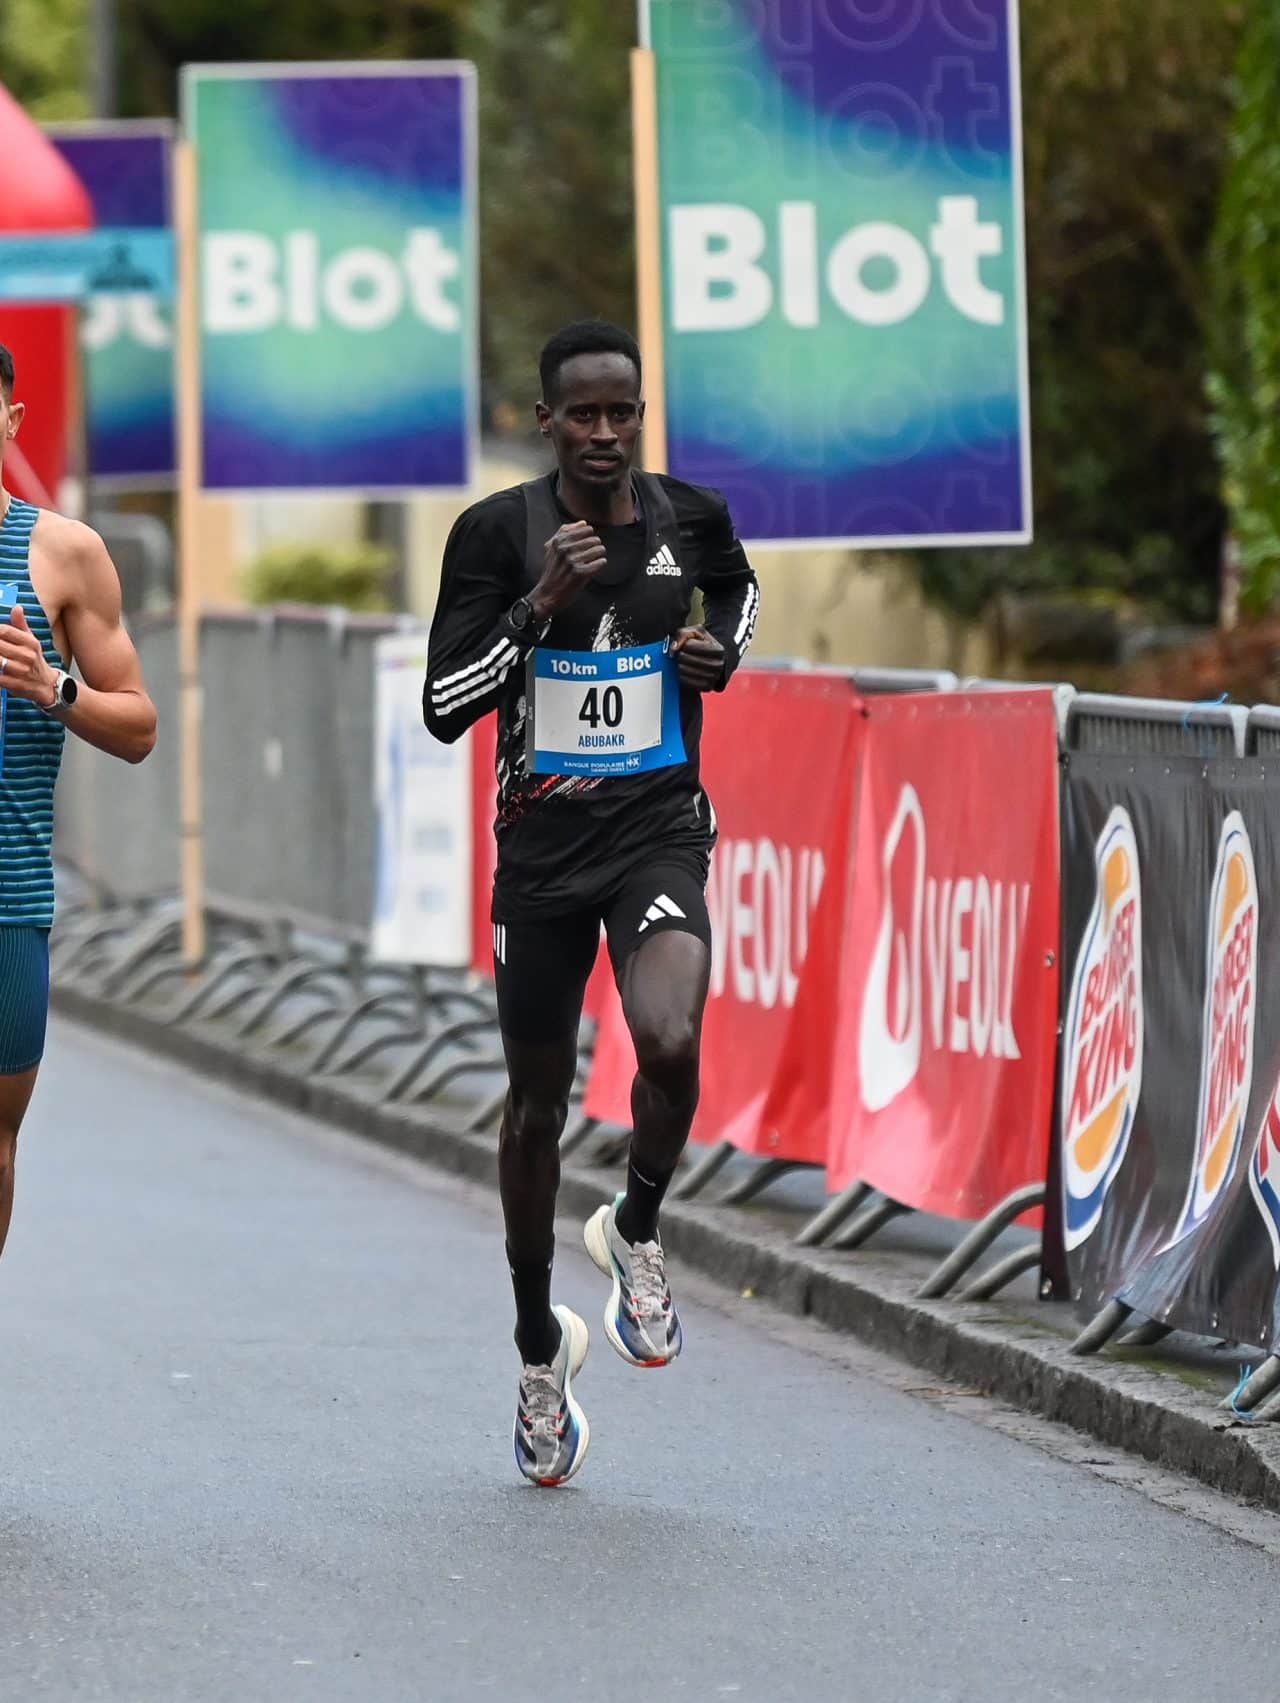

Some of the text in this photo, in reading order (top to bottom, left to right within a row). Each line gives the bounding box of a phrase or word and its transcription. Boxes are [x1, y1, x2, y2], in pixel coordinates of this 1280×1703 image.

[203, 227, 461, 333] Blot
[670, 195, 1005, 331] Blot
[646, 563, 682, 577] adidas
[616, 654, 651, 673] Blot
[578, 685, 624, 729] 40
[578, 734, 625, 748] ABUBAKR
[927, 872, 1031, 1060] VEOLI
[1065, 969, 1136, 1140] KING
